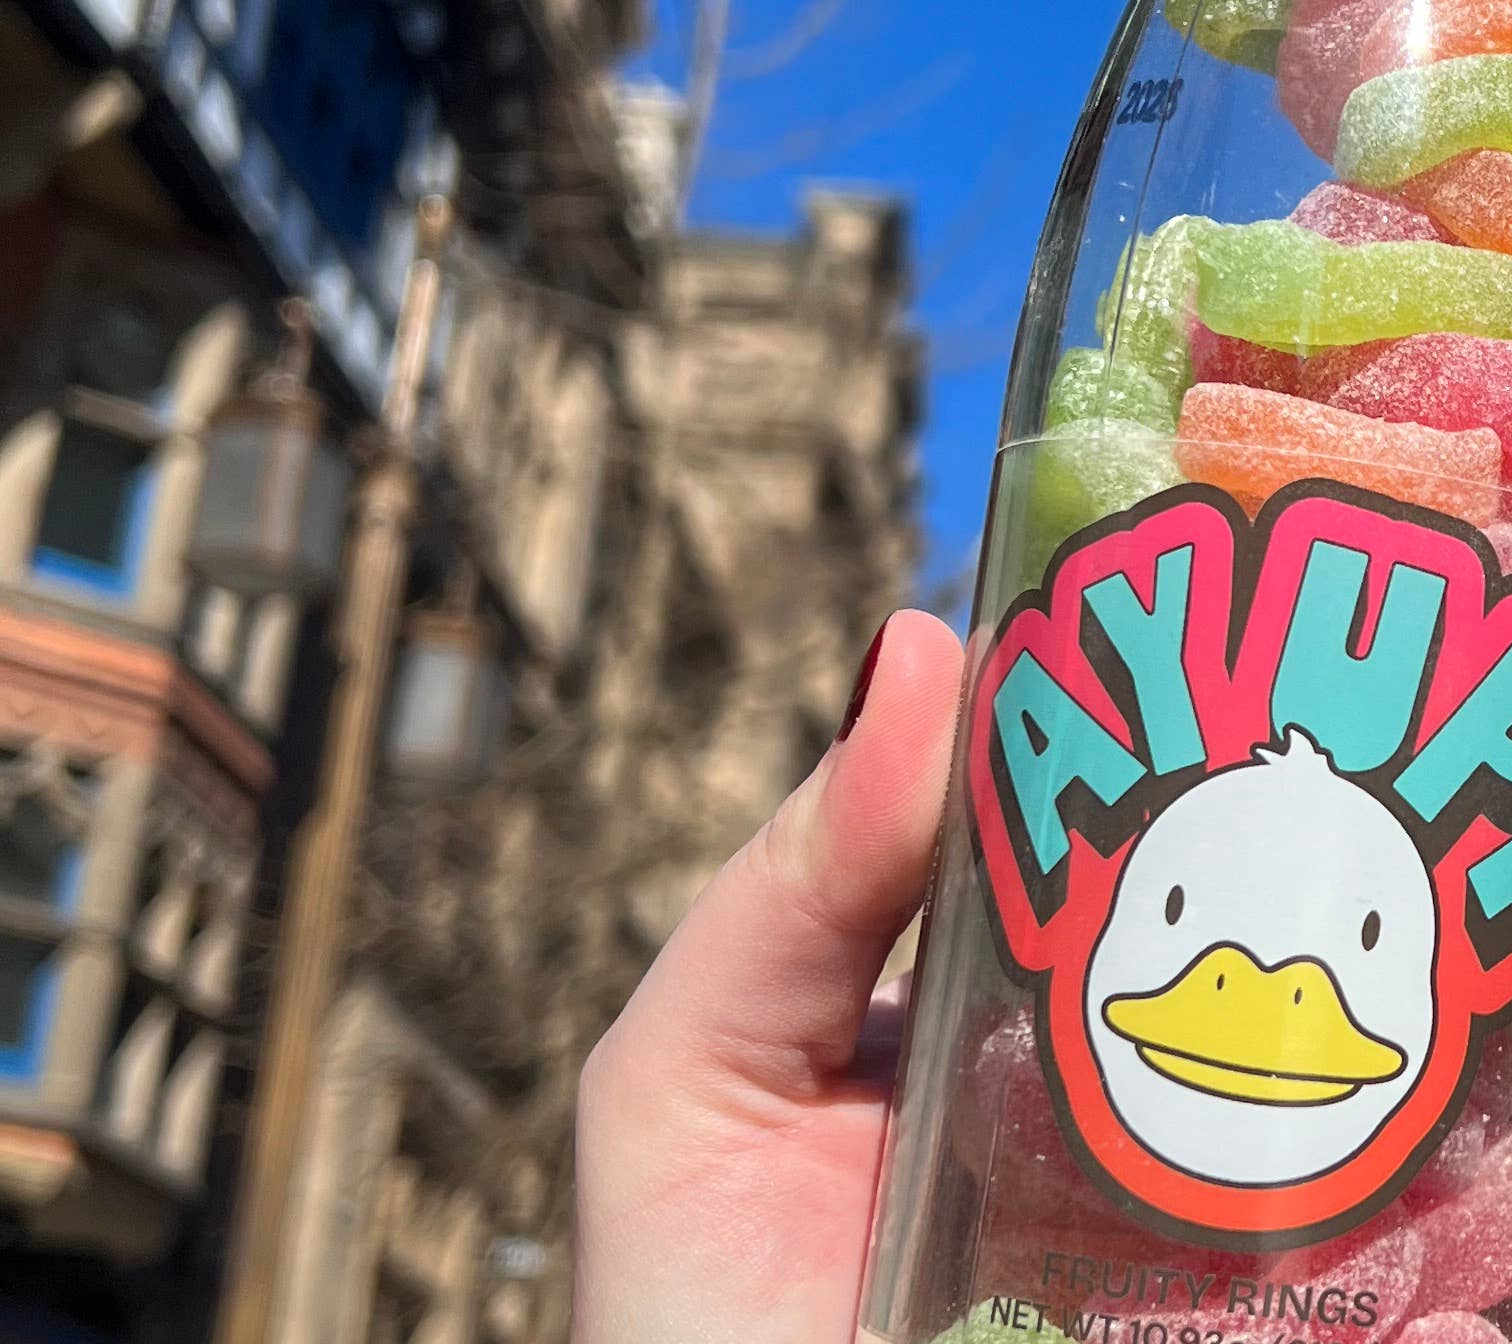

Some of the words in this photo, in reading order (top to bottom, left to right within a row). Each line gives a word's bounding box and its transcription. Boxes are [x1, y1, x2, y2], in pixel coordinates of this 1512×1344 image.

[993, 542, 1207, 876] AY
[989, 1294, 1053, 1334] NET
[1040, 1251, 1217, 1310] FRUITY
[1226, 1276, 1380, 1329] RINGS
